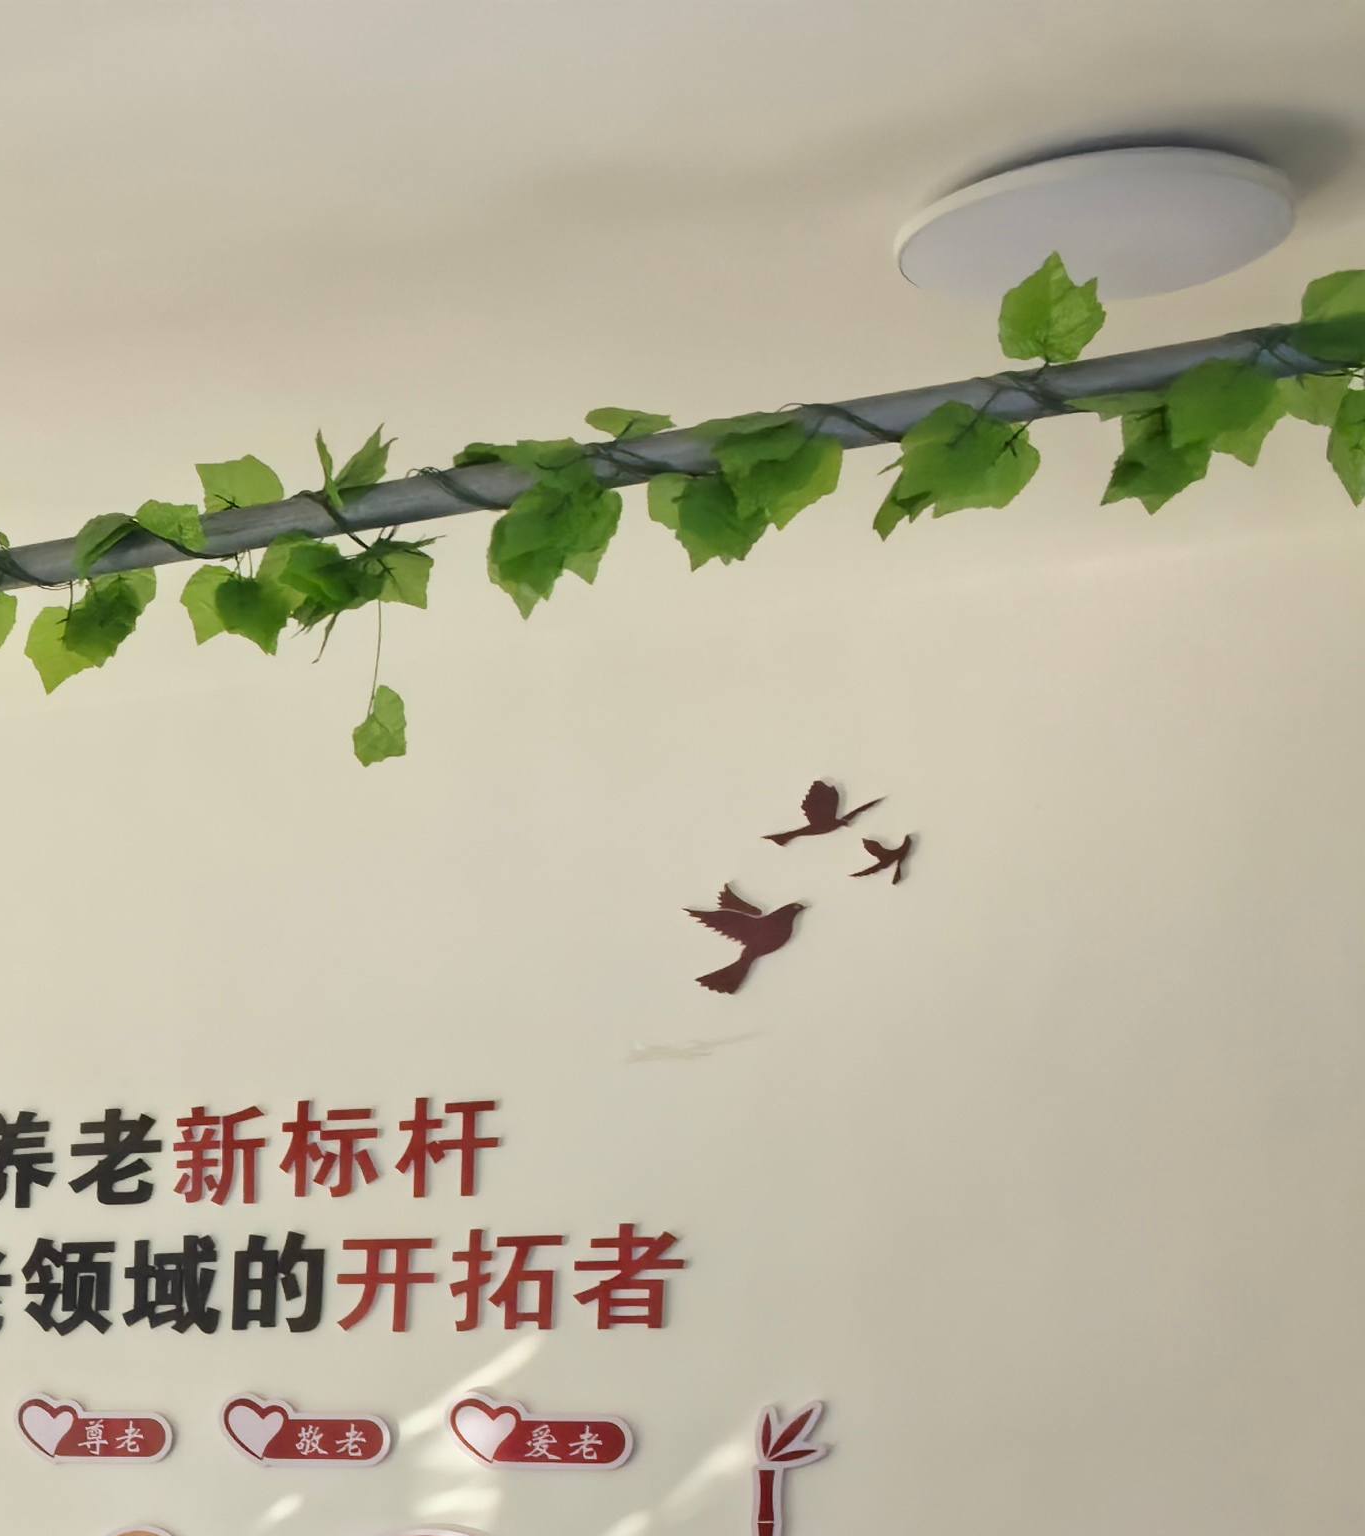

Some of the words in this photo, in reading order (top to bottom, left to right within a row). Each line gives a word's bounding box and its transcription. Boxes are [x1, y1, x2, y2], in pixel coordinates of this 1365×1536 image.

[77, 1418, 145, 1456] 尊老
[295, 1423, 367, 1458] 敬老
[523, 1424, 604, 1461] 爱老
